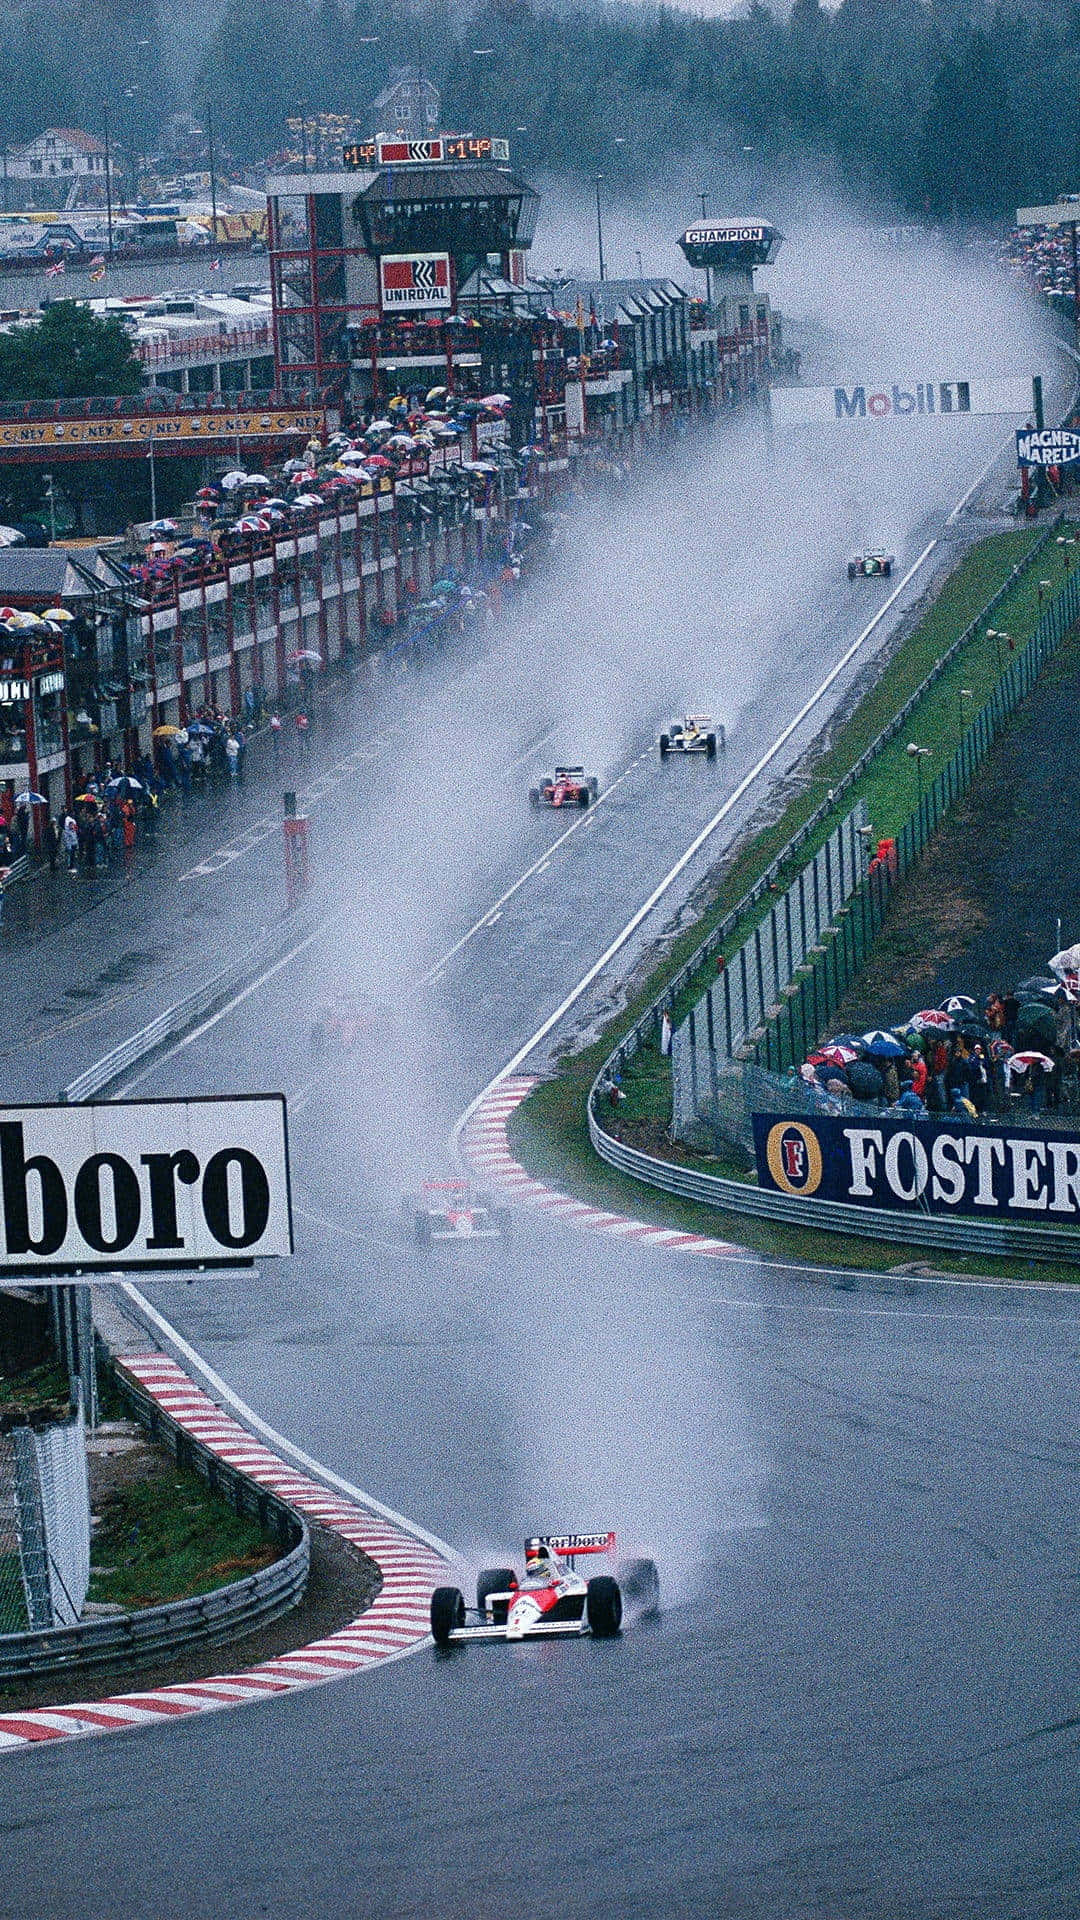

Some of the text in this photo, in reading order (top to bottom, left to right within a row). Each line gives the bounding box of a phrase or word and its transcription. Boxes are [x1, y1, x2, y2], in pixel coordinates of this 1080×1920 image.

[689, 229, 760, 242] CHAMPION
[385, 288, 447, 301] UNIROYAL
[835, 383, 935, 418] Mobil
[843, 1128, 1080, 1212] FOSTER
[0, 1121, 270, 1256] boro
